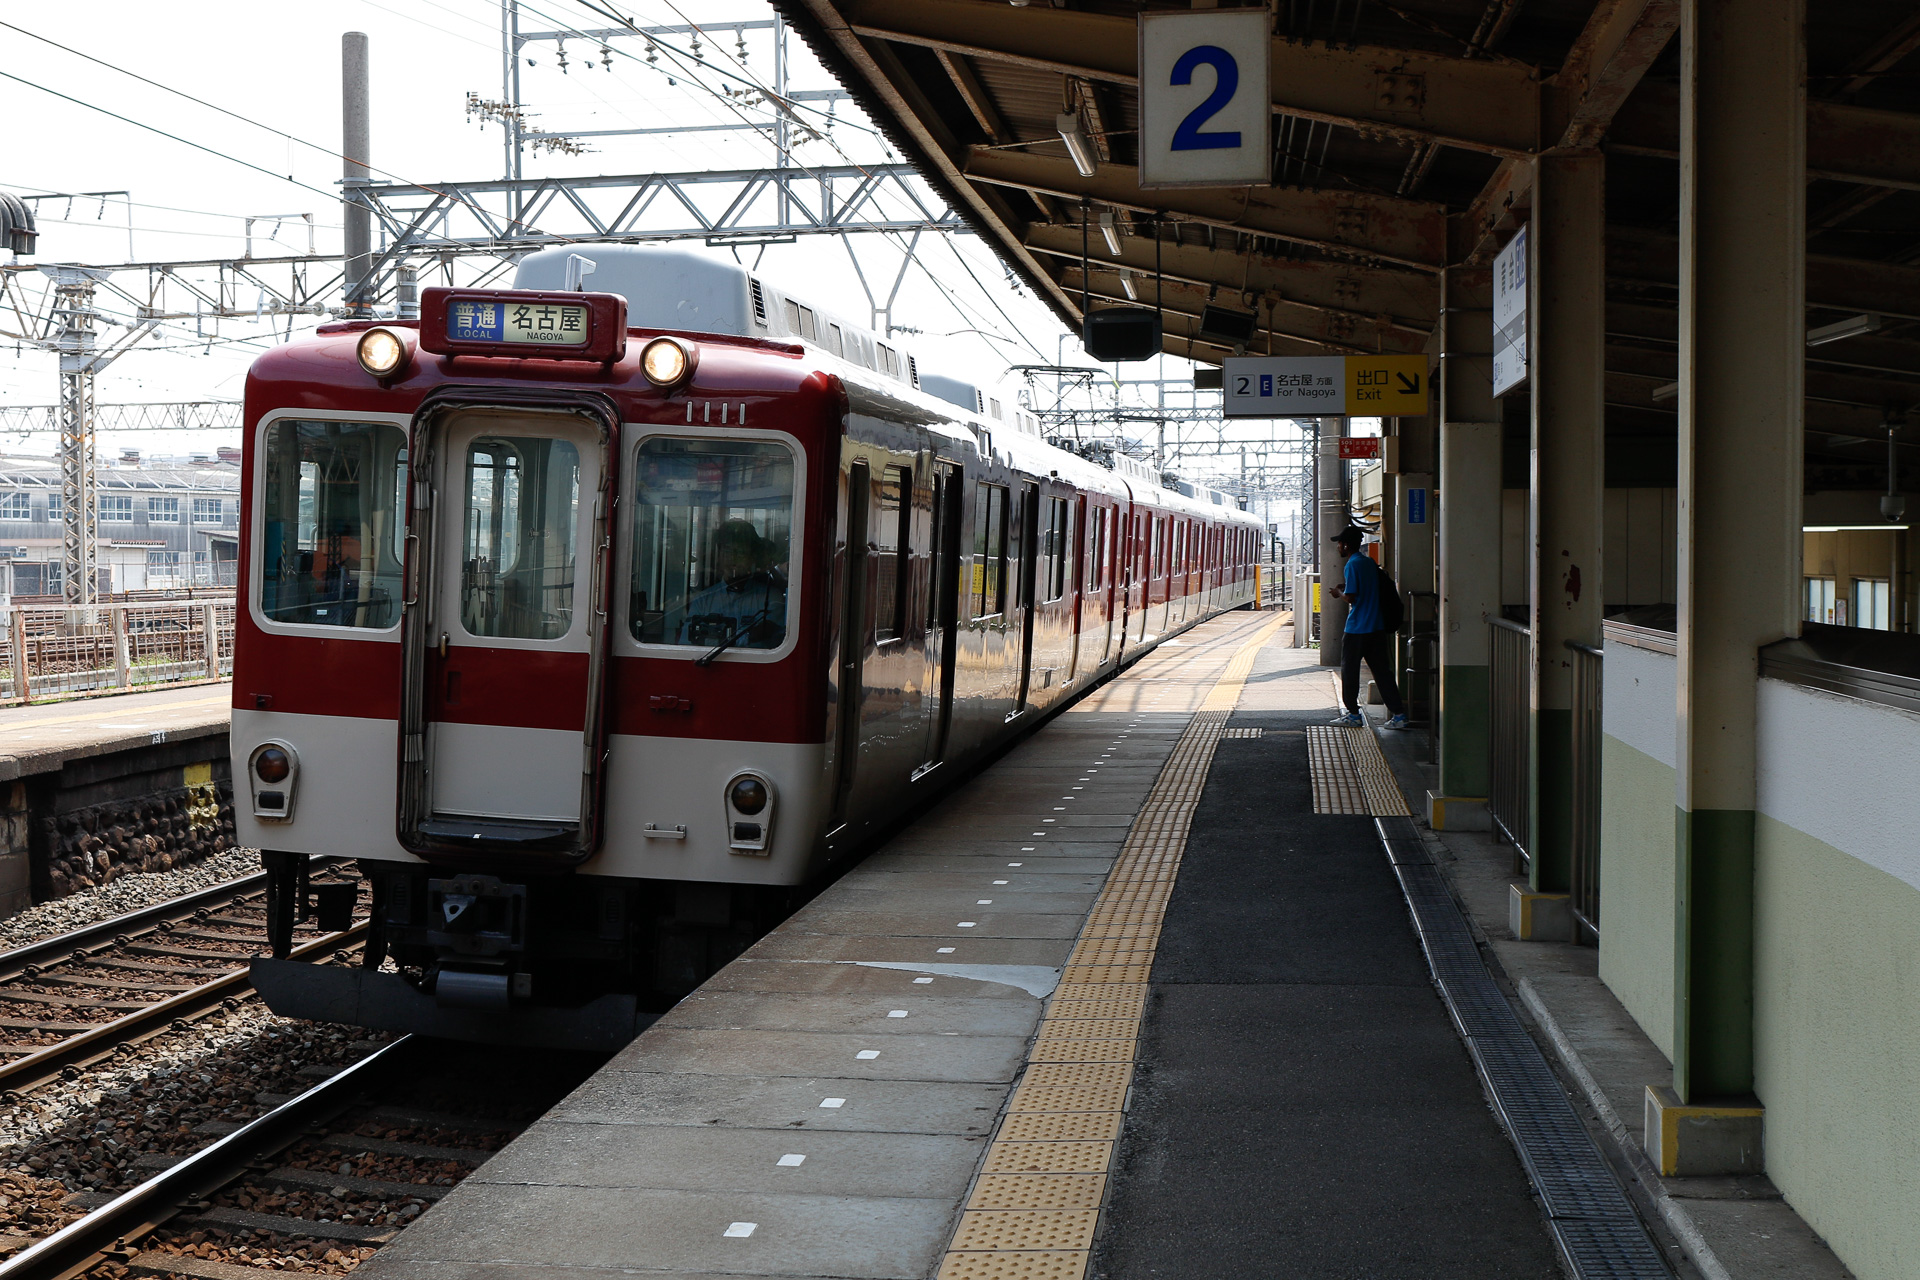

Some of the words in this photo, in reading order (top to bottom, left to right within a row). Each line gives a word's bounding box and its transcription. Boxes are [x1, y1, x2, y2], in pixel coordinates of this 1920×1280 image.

[1169, 44, 1242, 152] 2
[455, 302, 497, 329] 普通
[511, 304, 582, 332] 名古屋
[457, 329, 493, 339] LOCAL
[526, 331, 564, 341] NAGOYA
[1277, 374, 1313, 386] 名古屋
[1316, 377, 1333, 386] 方面
[1357, 370, 1388, 386] 出口
[1236, 377, 1250, 395] 2
[1263, 381, 1270, 391] E
[1277, 388, 1294, 397] For
[1298, 388, 1336, 398] Nagoya
[1357, 389, 1382, 400] Exit
